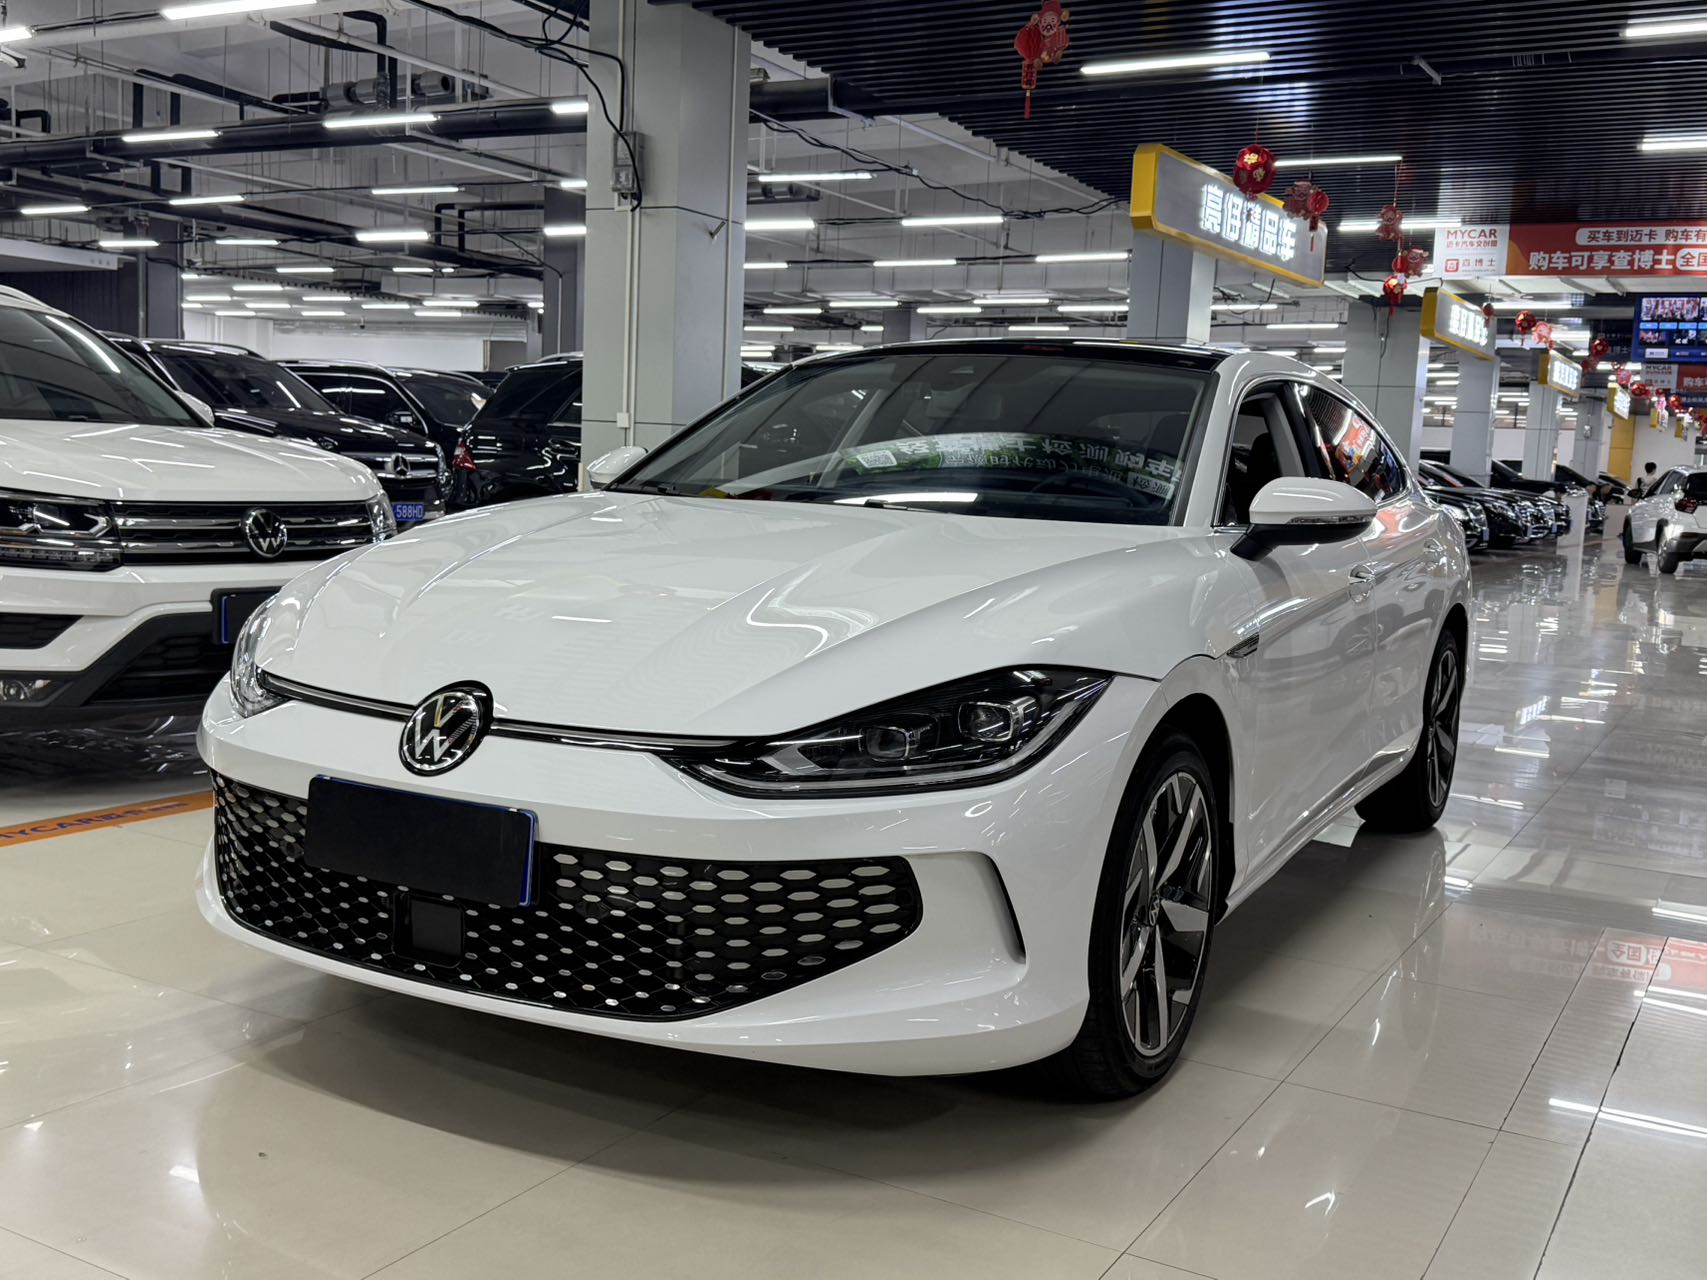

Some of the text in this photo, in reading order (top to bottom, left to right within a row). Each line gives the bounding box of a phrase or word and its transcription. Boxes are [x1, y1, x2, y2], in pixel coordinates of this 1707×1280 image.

[1446, 228, 1498, 239] MYCAR
[1587, 228, 1707, 243] 买车到迈卡 购车有
[1529, 249, 1675, 271] 购车可享查博士
